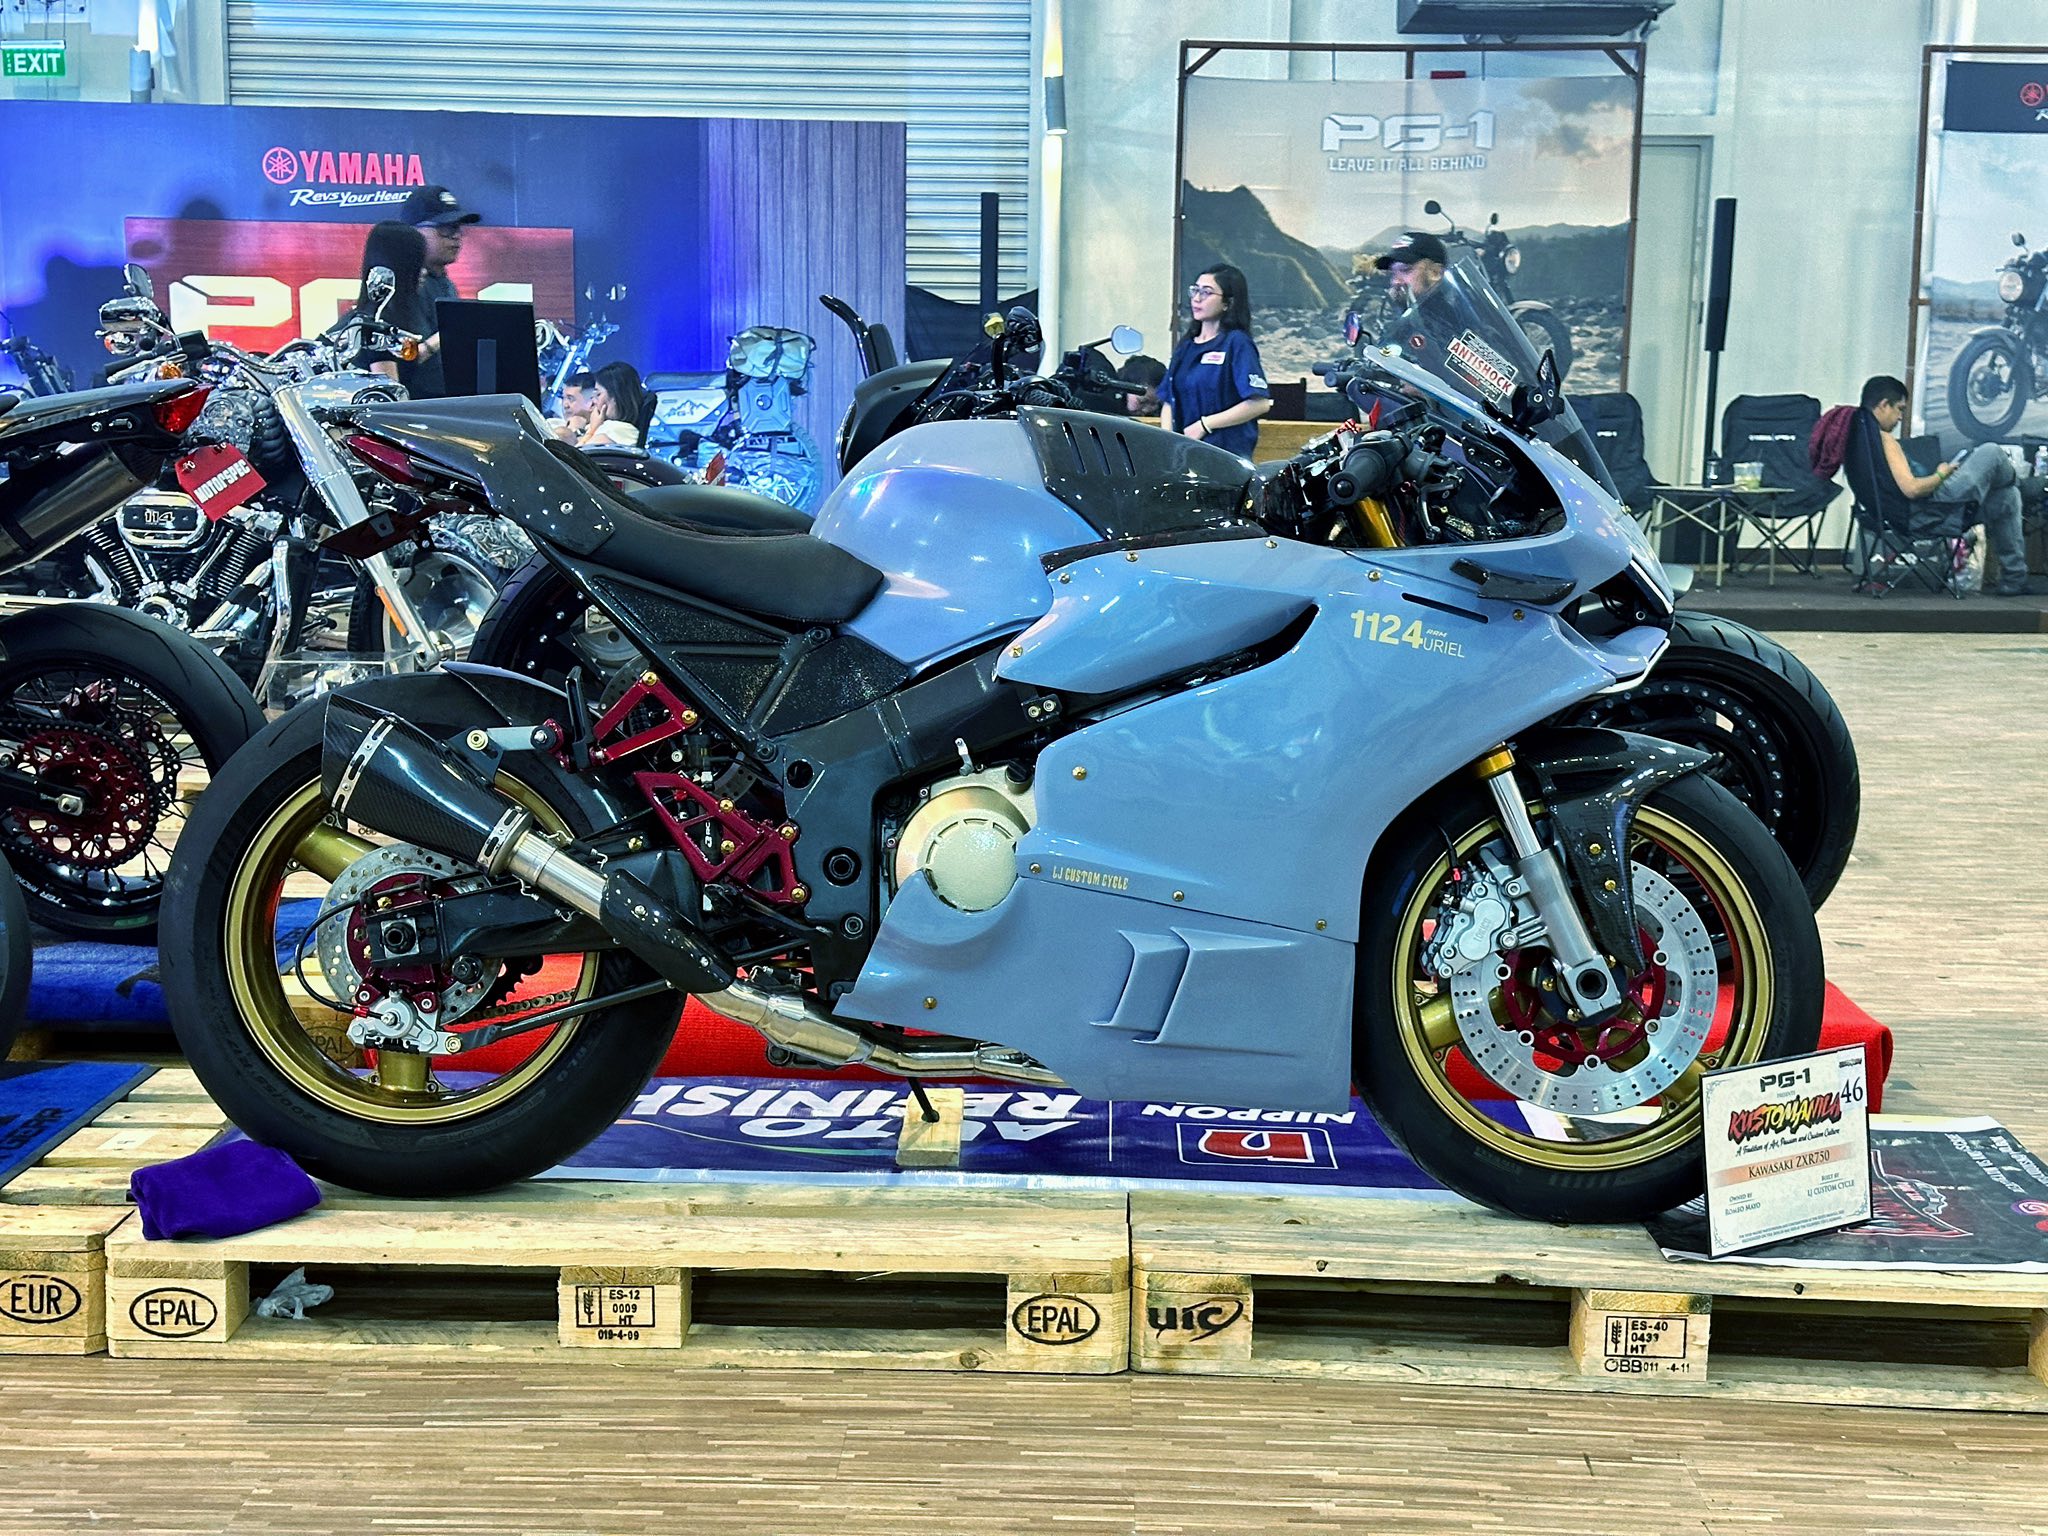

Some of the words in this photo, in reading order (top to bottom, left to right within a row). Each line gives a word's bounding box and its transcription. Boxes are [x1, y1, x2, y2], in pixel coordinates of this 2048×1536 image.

[14, 53, 61, 73] EXIT
[1321, 110, 1495, 152] PG-1
[299, 150, 426, 187] YAMAHA
[1329, 157, 1375, 172] LEAVE
[1379, 157, 1395, 172] IT
[1399, 157, 1425, 171] ALL
[1430, 154, 1488, 171] BEHIND
[1450, 341, 1513, 393] ANTISHOCK
[144, 510, 175, 523] 114
[1350, 609, 1424, 649] 1124
[1423, 637, 1465, 658] URIEL
[1065, 867, 1100, 886] CUSTOM
[1102, 873, 1129, 890] CYCLE
[1760, 1067, 1811, 1092] PG-1
[1841, 1077, 1863, 1103] 46
[1141, 1103, 1357, 1125] NIPPON
[1748, 1159, 1793, 1178] KAWASAKI
[1796, 1150, 1830, 1168] ZXR750
[1813, 1183, 1837, 1196] CUSTOM
[10, 1283, 62, 1315] EUR
[609, 1289, 640, 1300] ES-12
[145, 1299, 206, 1326] EPAL
[612, 1303, 637, 1313] 0009
[1027, 1305, 1088, 1333] EPAL
[619, 1315, 634, 1326] HT
[1631, 1320, 1668, 1331] ES-40
[1630, 1344, 1647, 1354] HT
